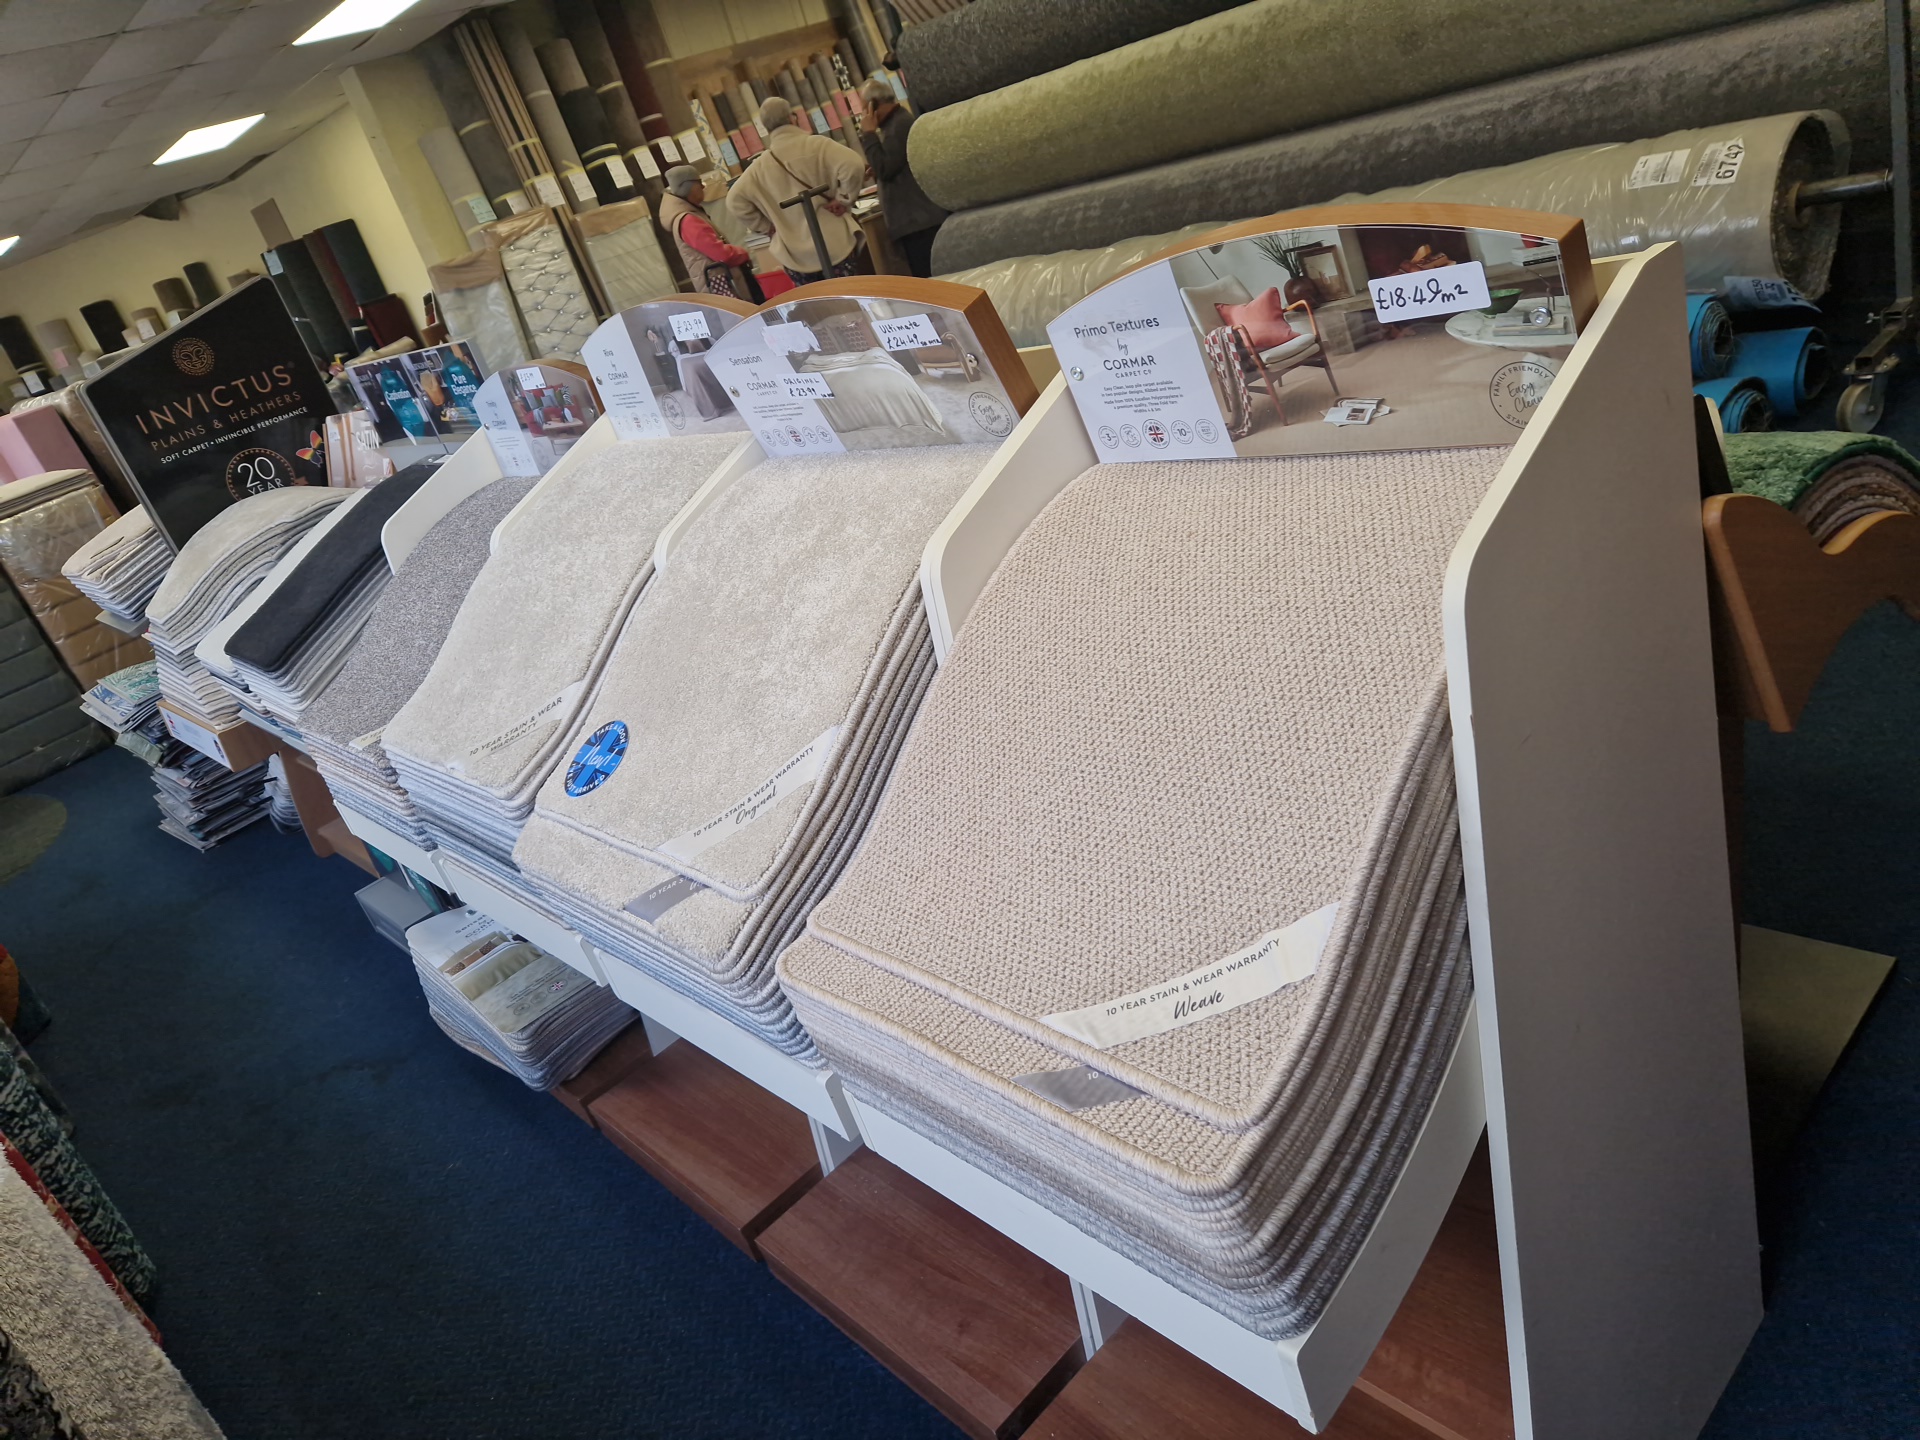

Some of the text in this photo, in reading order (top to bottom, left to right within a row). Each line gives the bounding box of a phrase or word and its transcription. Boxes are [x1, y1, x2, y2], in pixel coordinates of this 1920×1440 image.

[878, 320, 921, 334] Ultimate
[1073, 317, 1160, 339] Primo Textures
[886, 333, 920, 350] £24.49
[1116, 338, 1129, 356] by
[728, 353, 763, 366] Sensation
[1103, 355, 1157, 371] CORMAR
[451, 373, 468, 384] Pure
[607, 371, 629, 381] CORMAR
[783, 377, 820, 386] ORIGINAL
[1115, 370, 1141, 379] CARPET
[1493, 365, 1550, 397] FAMILY FRIENDLY
[451, 383, 477, 397] Elegance
[746, 380, 778, 391] CORMAR
[1506, 381, 1535, 398] Easy
[135, 365, 292, 435] INVICTUS
[977, 405, 995, 416] Easy
[151, 391, 301, 451] PLAINS & HEATHERS
[160, 406, 308, 464] SOFT CARPET INVINCIBLE PERFORMANCE
[355, 430, 380, 450] SATIN
[1106, 433, 1112, 442] 3
[1177, 428, 1187, 437] 10
[237, 456, 275, 488] 20
[469, 749, 478, 757] 10
[481, 735, 502, 751] YEAR
[504, 720, 528, 738] STAIN
[538, 696, 562, 717] WEAR
[596, 724, 614, 736] TAKE
[490, 720, 538, 752] WARRANTY
[574, 774, 606, 794] ARRIVED
[693, 829, 702, 838] 10
[703, 816, 723, 832] YEAR
[724, 802, 746, 819] STAIN
[753, 778, 774, 798] WEAR
[774, 746, 815, 780] WARRANTY
[735, 785, 778, 825] Original
[649, 892, 657, 900] 10
[658, 880, 677, 894] YEAR
[454, 914, 487, 934] Sensat
[1105, 938, 1280, 1017] 10 YEAR STAIN & WEAR WARRANTY
[1174, 989, 1225, 1020] Weave
[1086, 1071, 1099, 1080] 10
